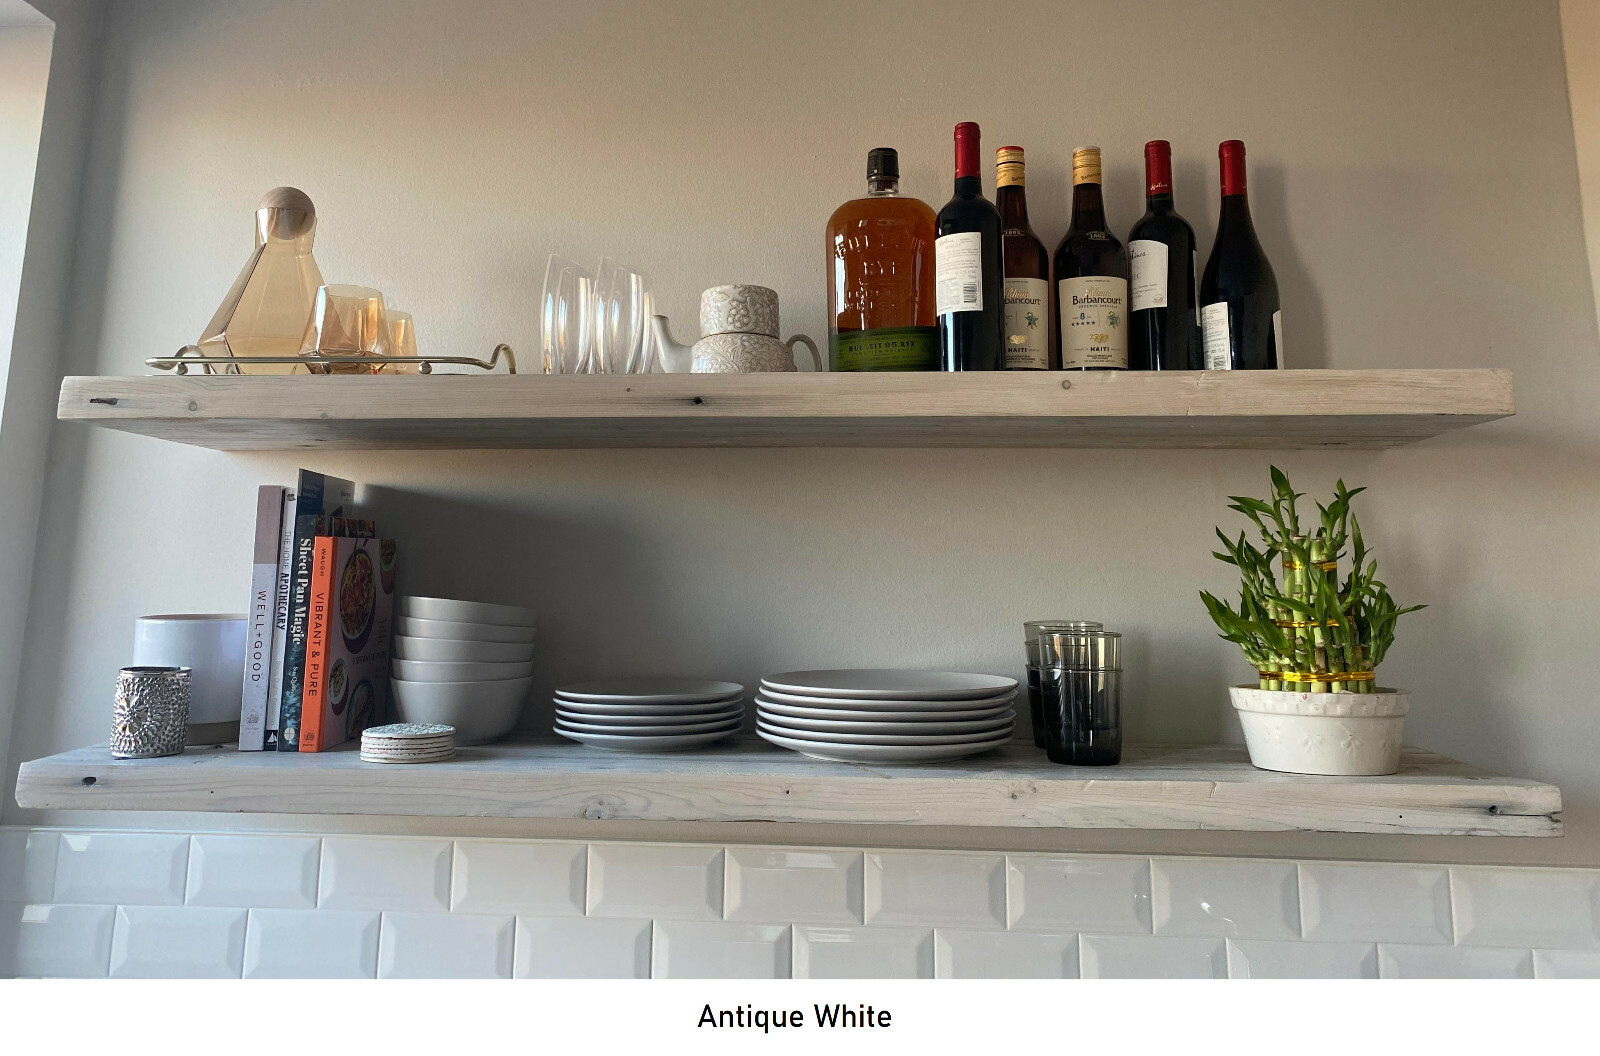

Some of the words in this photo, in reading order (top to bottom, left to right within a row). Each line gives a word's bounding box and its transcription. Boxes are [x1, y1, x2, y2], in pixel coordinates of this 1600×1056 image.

[1004, 297, 1041, 306] bancourt
[1072, 295, 1121, 306] Barbancourt
[1080, 312, 1086, 320] 8
[884, 341, 897, 349] 95
[283, 531, 292, 545] THE
[281, 547, 291, 569] HOME
[298, 538, 312, 576] Sheet
[319, 548, 327, 577] WAUGH
[276, 572, 290, 630] APOTHECARY
[295, 578, 308, 603] Pan
[291, 606, 307, 645] Magic
[312, 592, 325, 647] VIBRANT
[251, 590, 267, 682] WELL+GOOD
[311, 650, 320, 659] &
[308, 663, 320, 697] PURE
